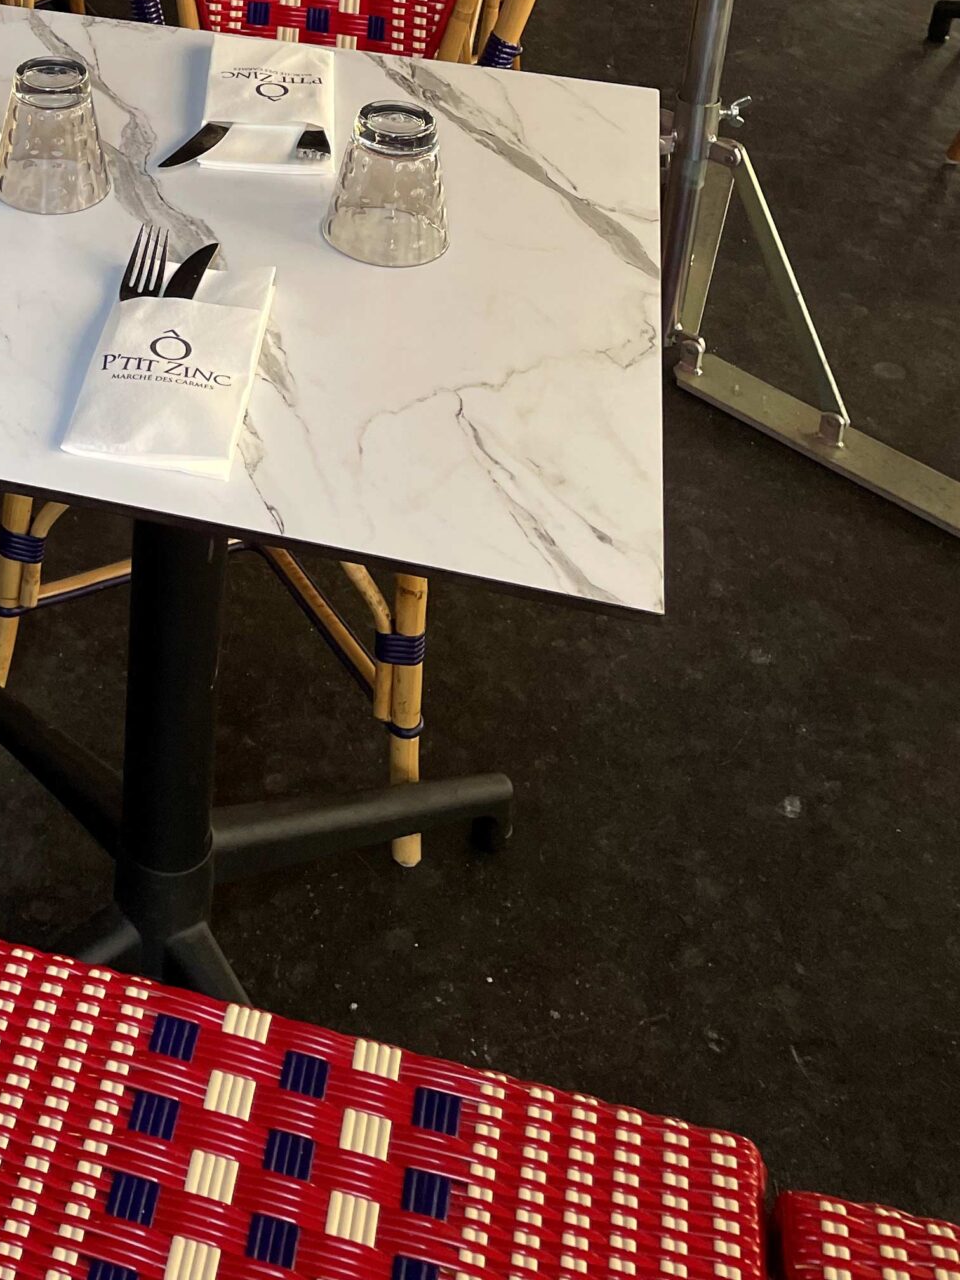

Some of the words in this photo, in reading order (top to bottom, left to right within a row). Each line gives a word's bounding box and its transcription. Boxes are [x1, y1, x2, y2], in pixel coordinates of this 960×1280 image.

[220, 71, 273, 83] ZINC
[149, 328, 192, 361] Ô
[101, 353, 160, 373] P'TIT
[163, 360, 232, 387] ZINC
[154, 375, 174, 383] DES
[175, 379, 215, 391] CARMES
